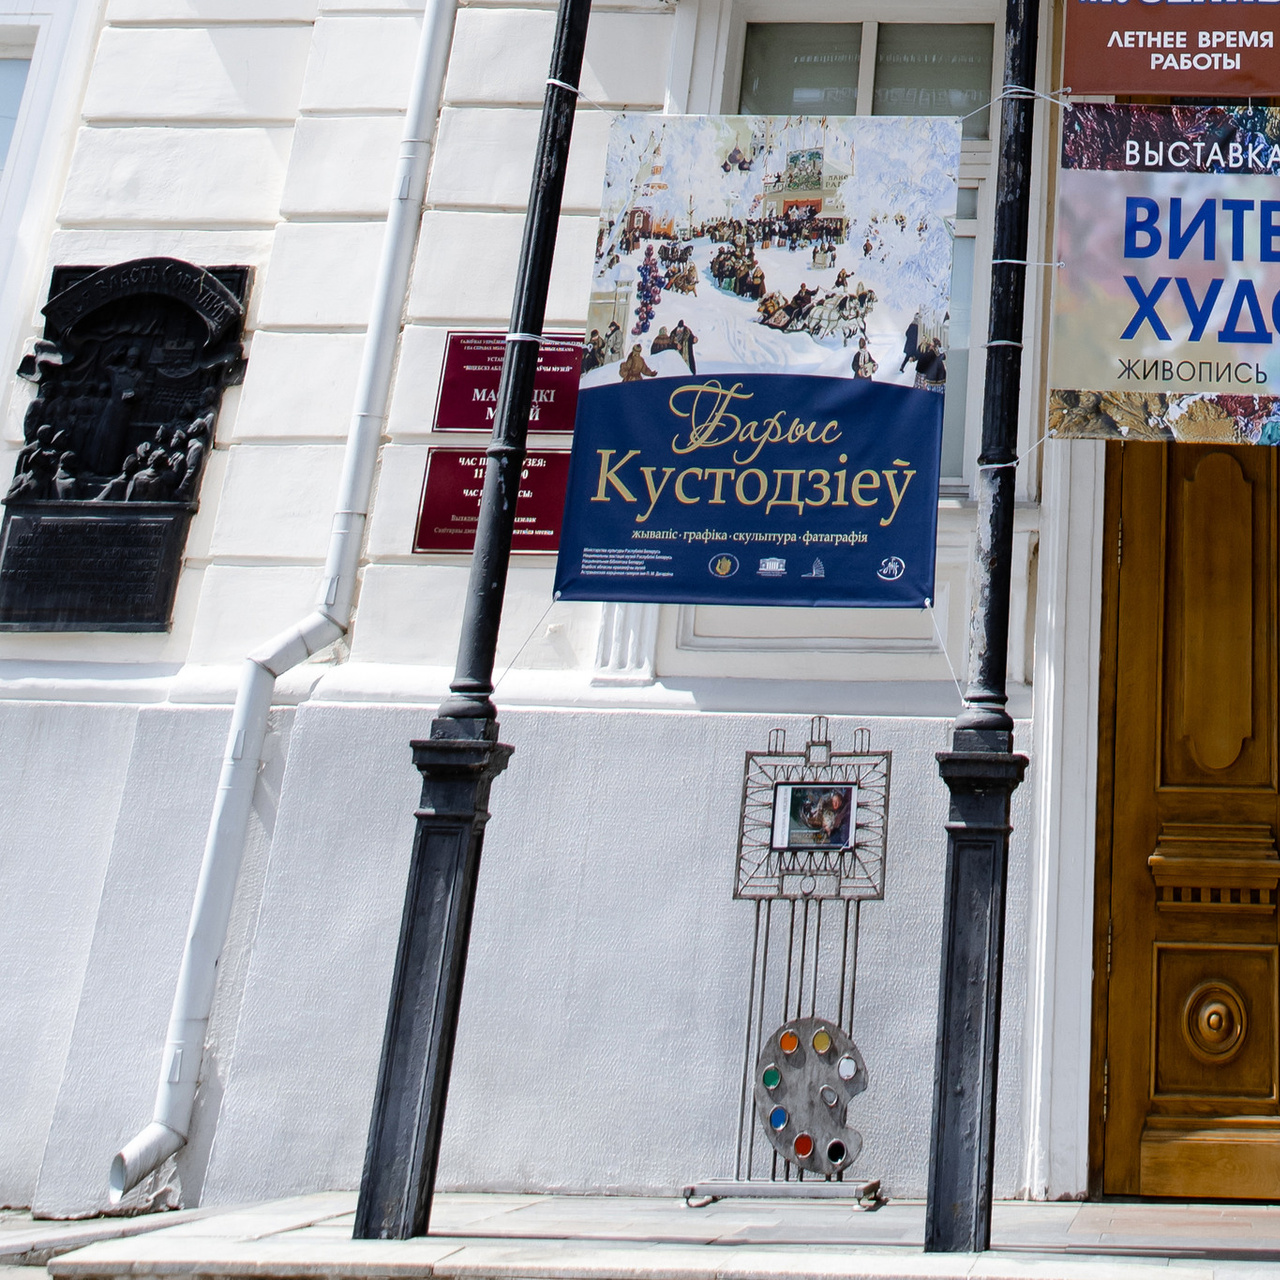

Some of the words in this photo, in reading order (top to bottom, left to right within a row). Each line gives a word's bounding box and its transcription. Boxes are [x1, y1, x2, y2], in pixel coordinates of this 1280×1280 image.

[1107, 31, 1187, 49] ЛЕТНЕЕ
[1198, 31, 1274, 49] ВРЕМЯ
[1150, 53, 1241, 71] РАБОТЫ
[1117, 358, 1267, 384] ЖИВОПИСЬ
[669, 379, 842, 465] Барыс
[590, 449, 917, 527] Кустодзіеў
